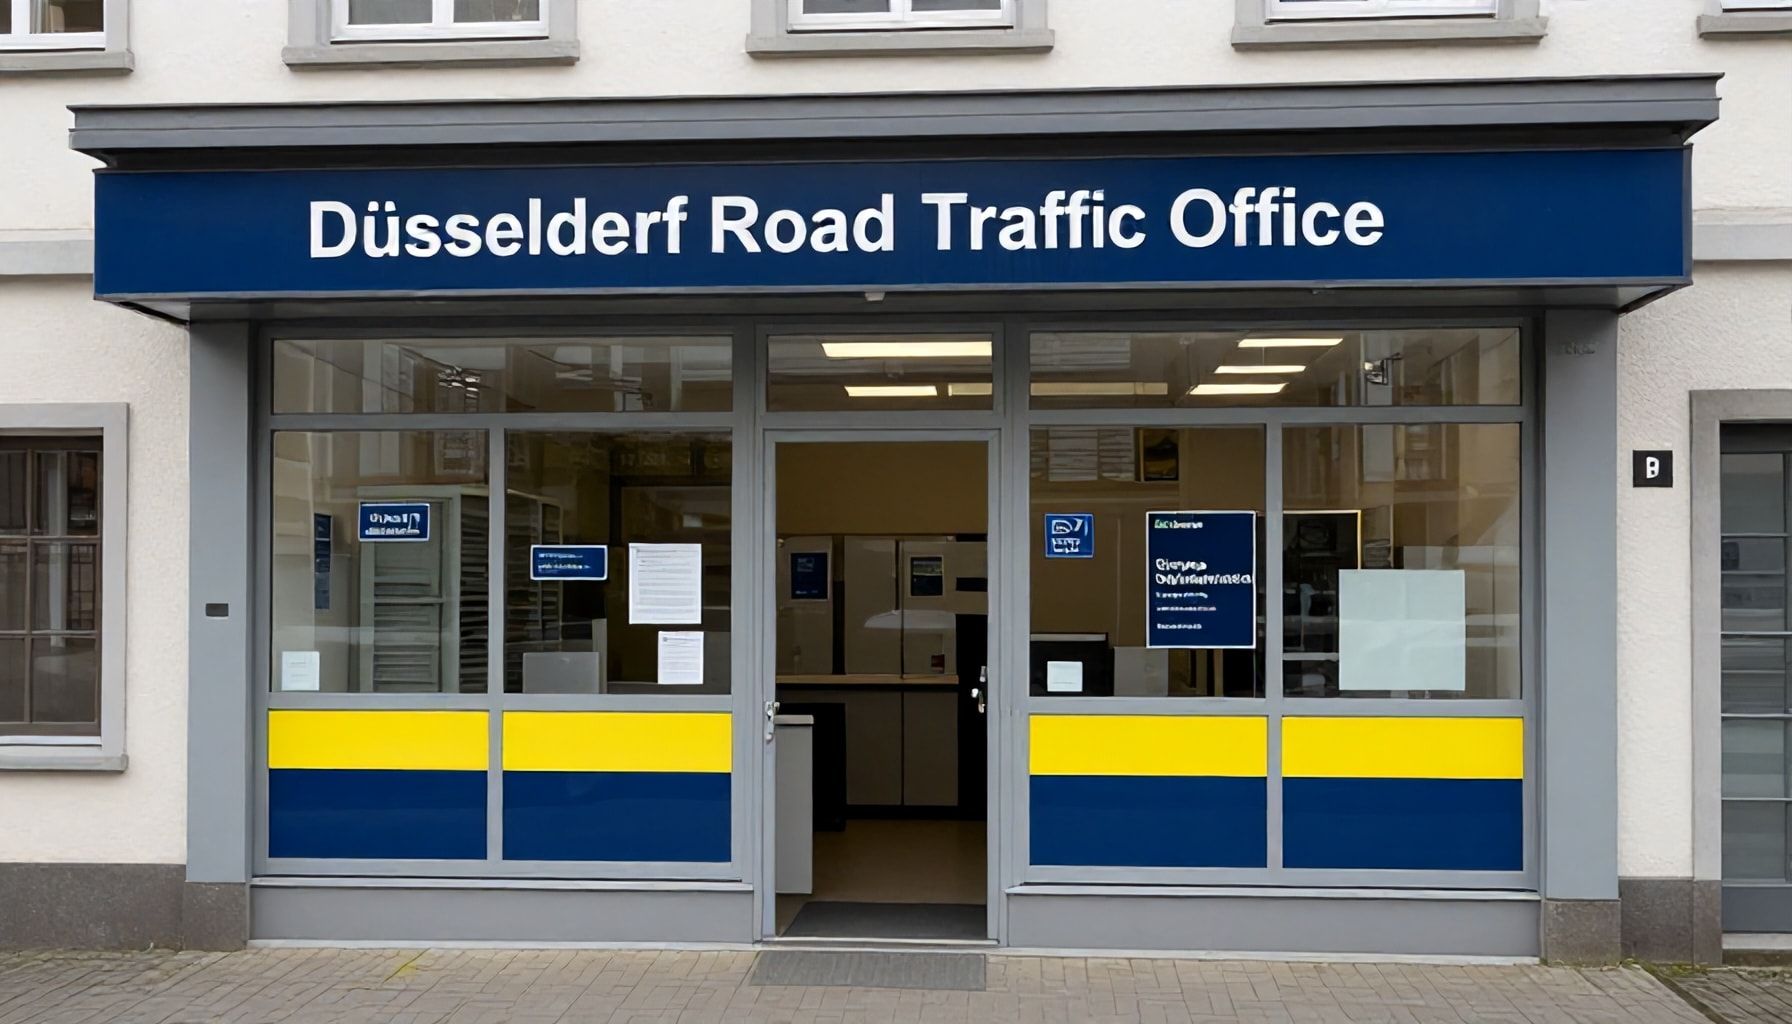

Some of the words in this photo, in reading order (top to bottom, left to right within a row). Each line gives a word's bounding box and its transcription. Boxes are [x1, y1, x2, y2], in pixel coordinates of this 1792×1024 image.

[310, 196, 689, 258] Düsselderf
[711, 192, 894, 254] Road
[921, 189, 1146, 252] Traffic
[1169, 186, 1385, 248] Office
